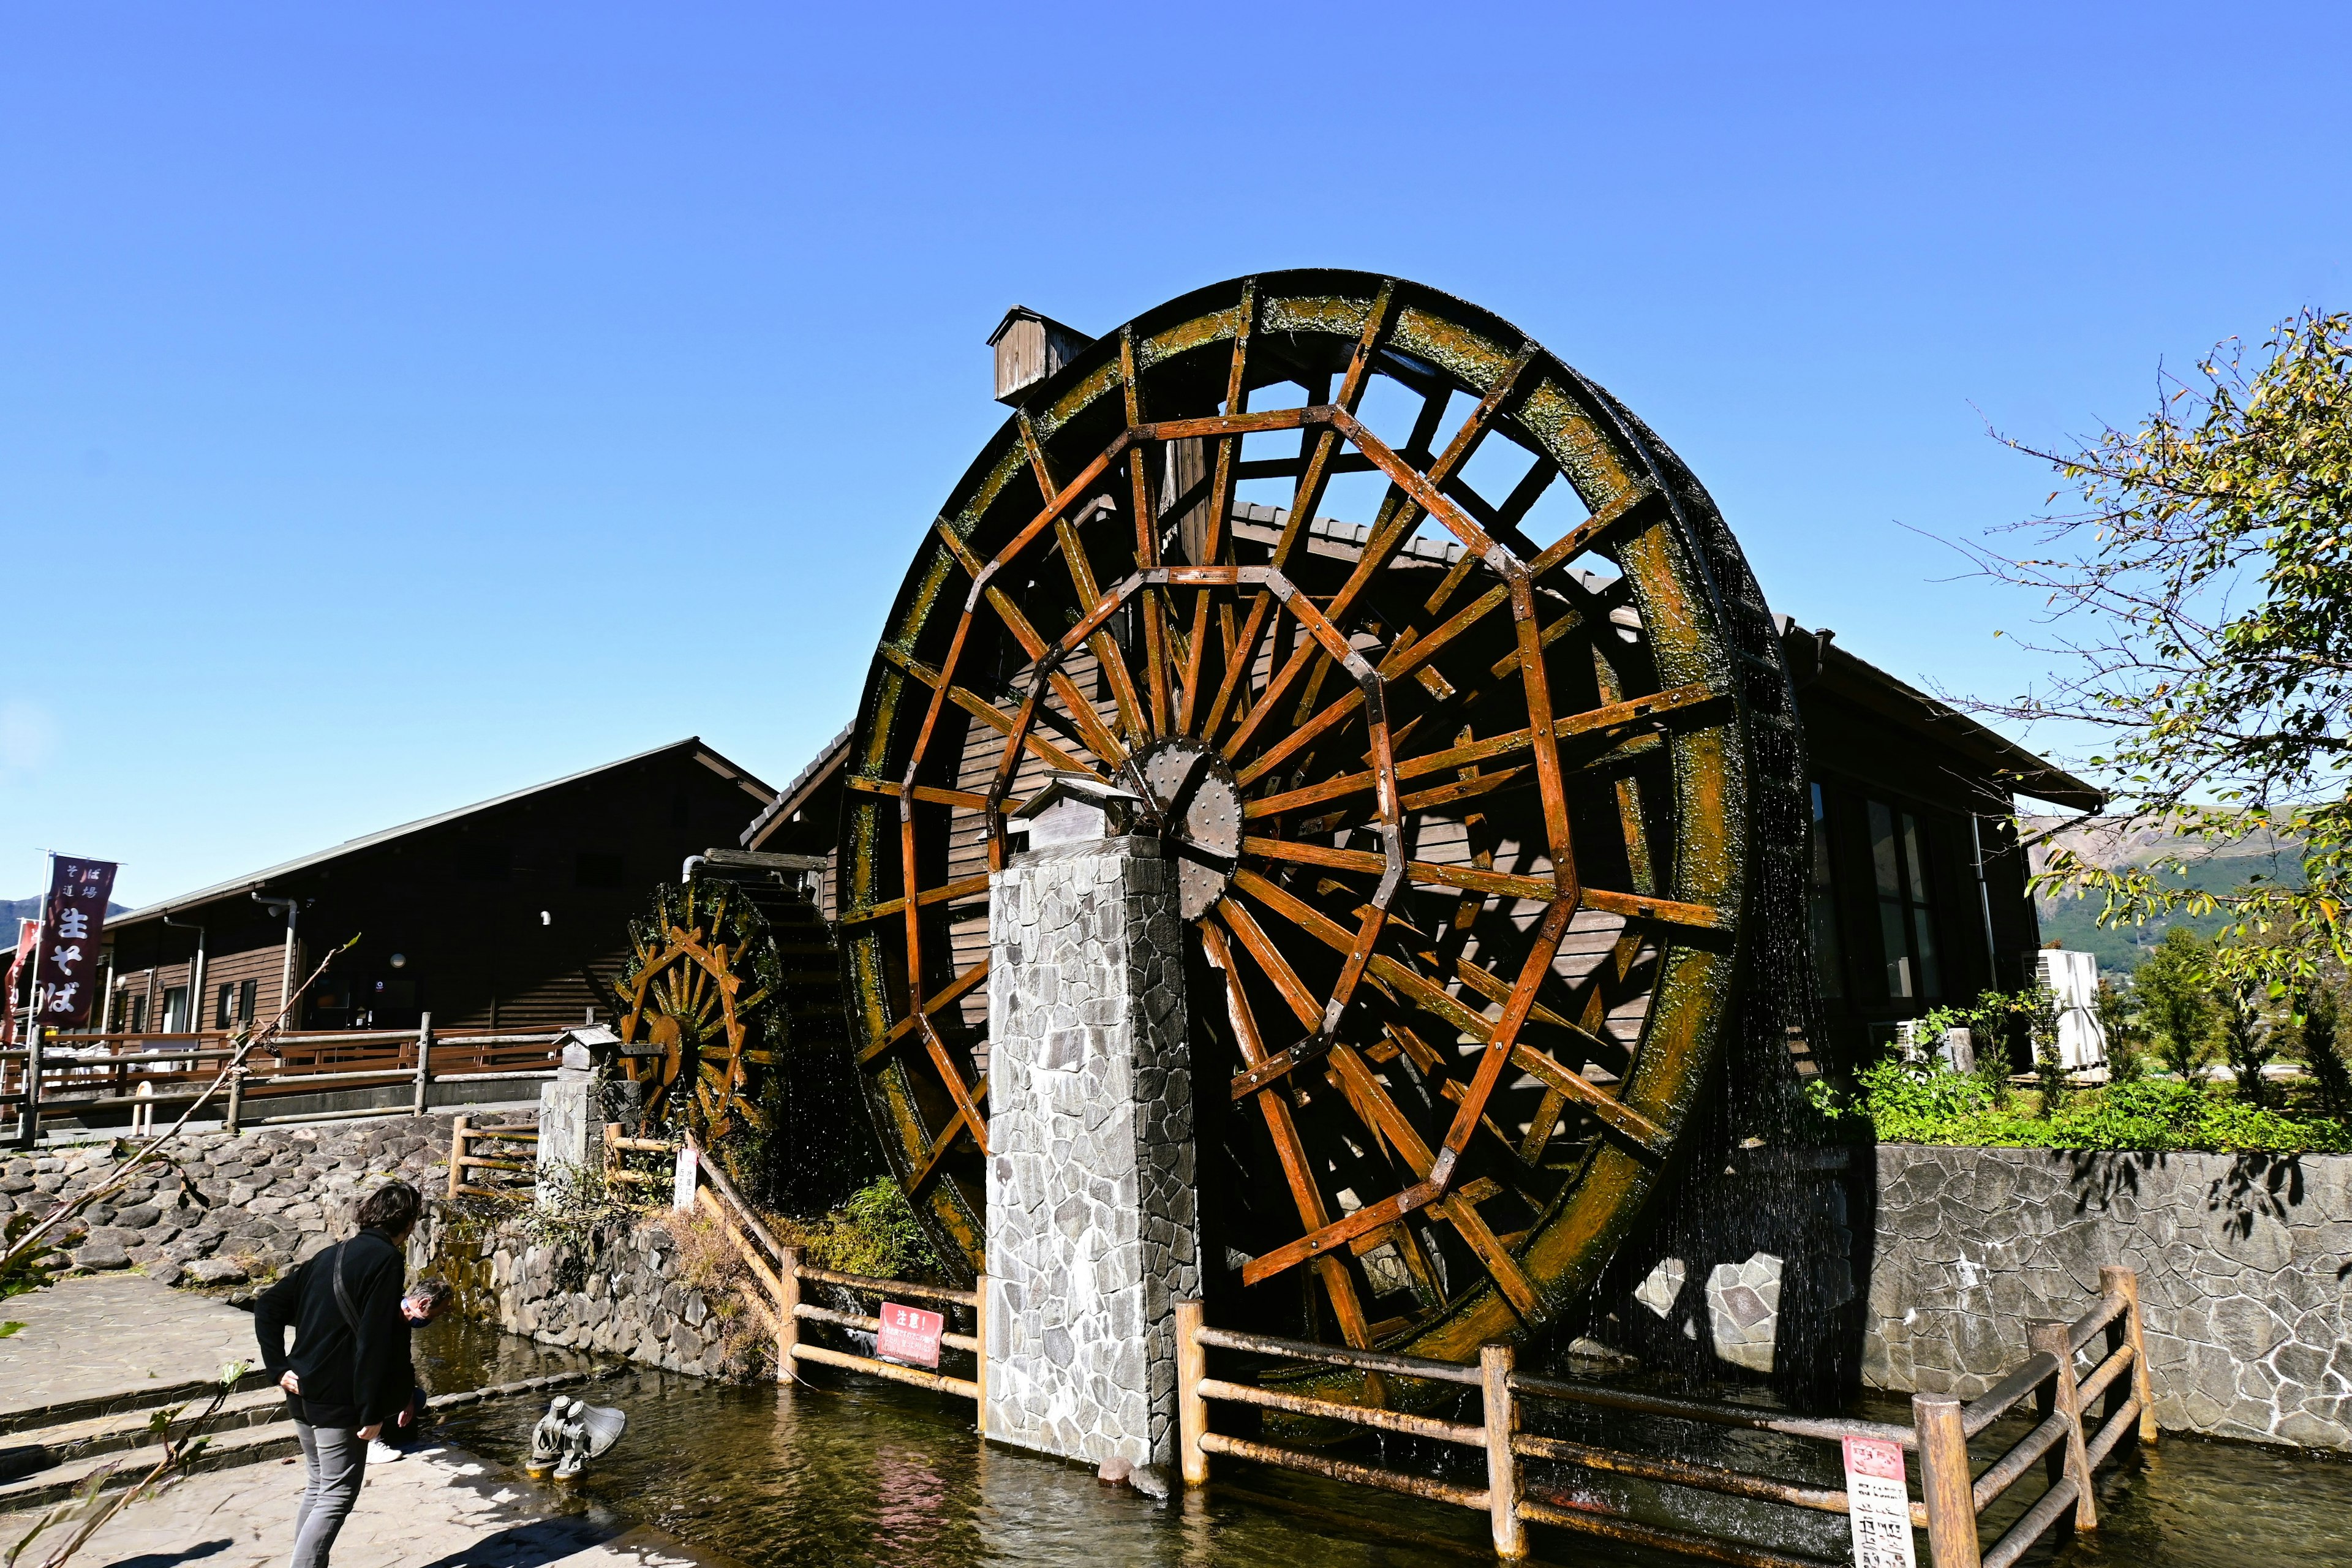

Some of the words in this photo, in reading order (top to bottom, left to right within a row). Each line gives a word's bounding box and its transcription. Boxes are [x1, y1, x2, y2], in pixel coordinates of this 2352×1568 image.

[62, 884, 97, 899] 道場
[47, 908, 88, 1012] 生そば
[896, 1310, 925, 1330] 注意!
